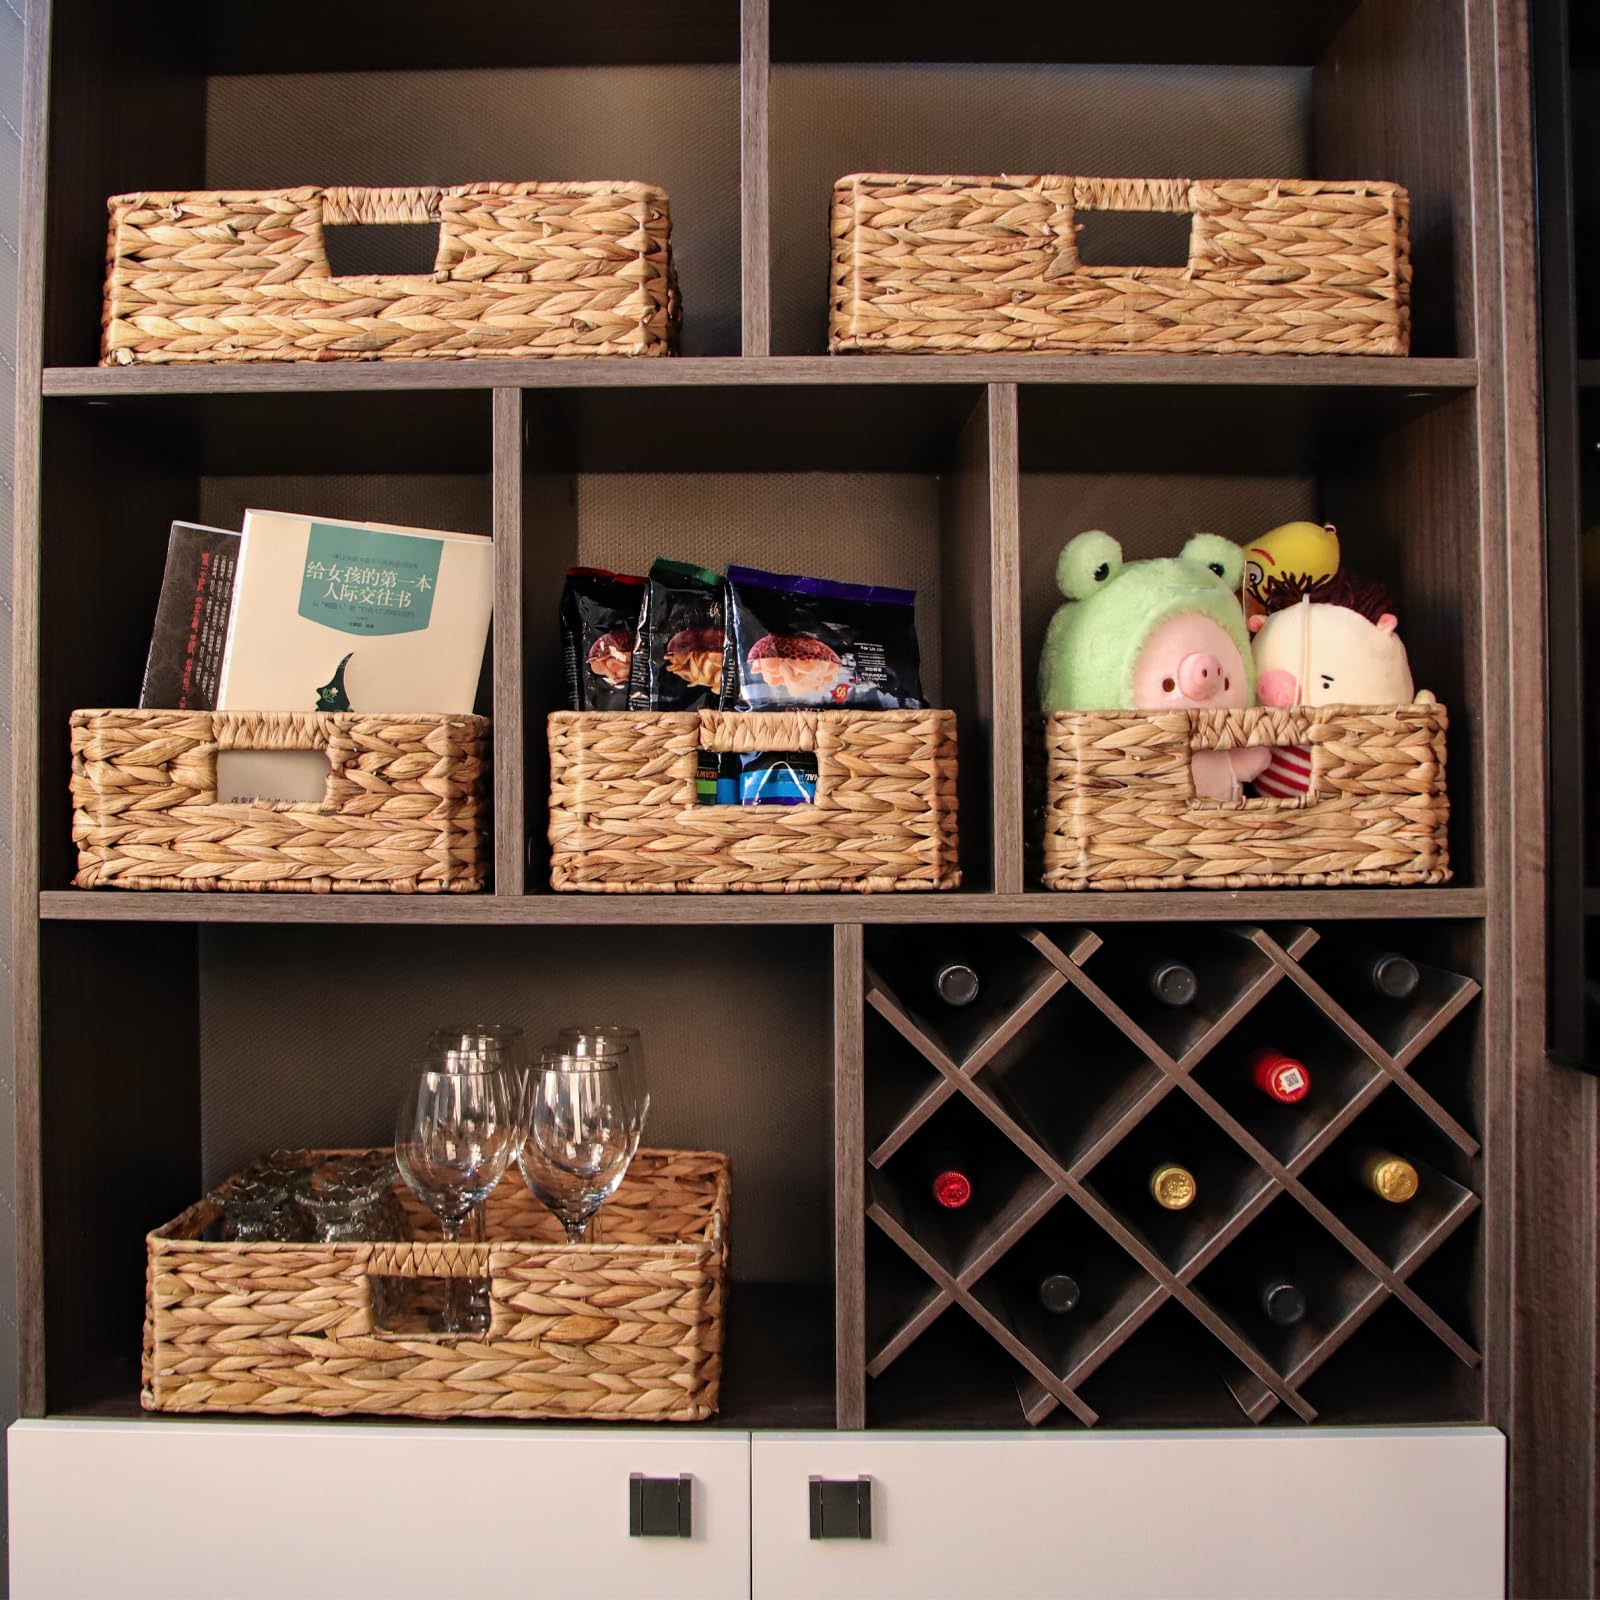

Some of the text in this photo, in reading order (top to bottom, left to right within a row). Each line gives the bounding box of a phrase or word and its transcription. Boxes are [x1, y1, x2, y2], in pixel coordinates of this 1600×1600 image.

[306, 561, 432, 592] 给女孩的第一本
[322, 582, 412, 608] 人际交往书
